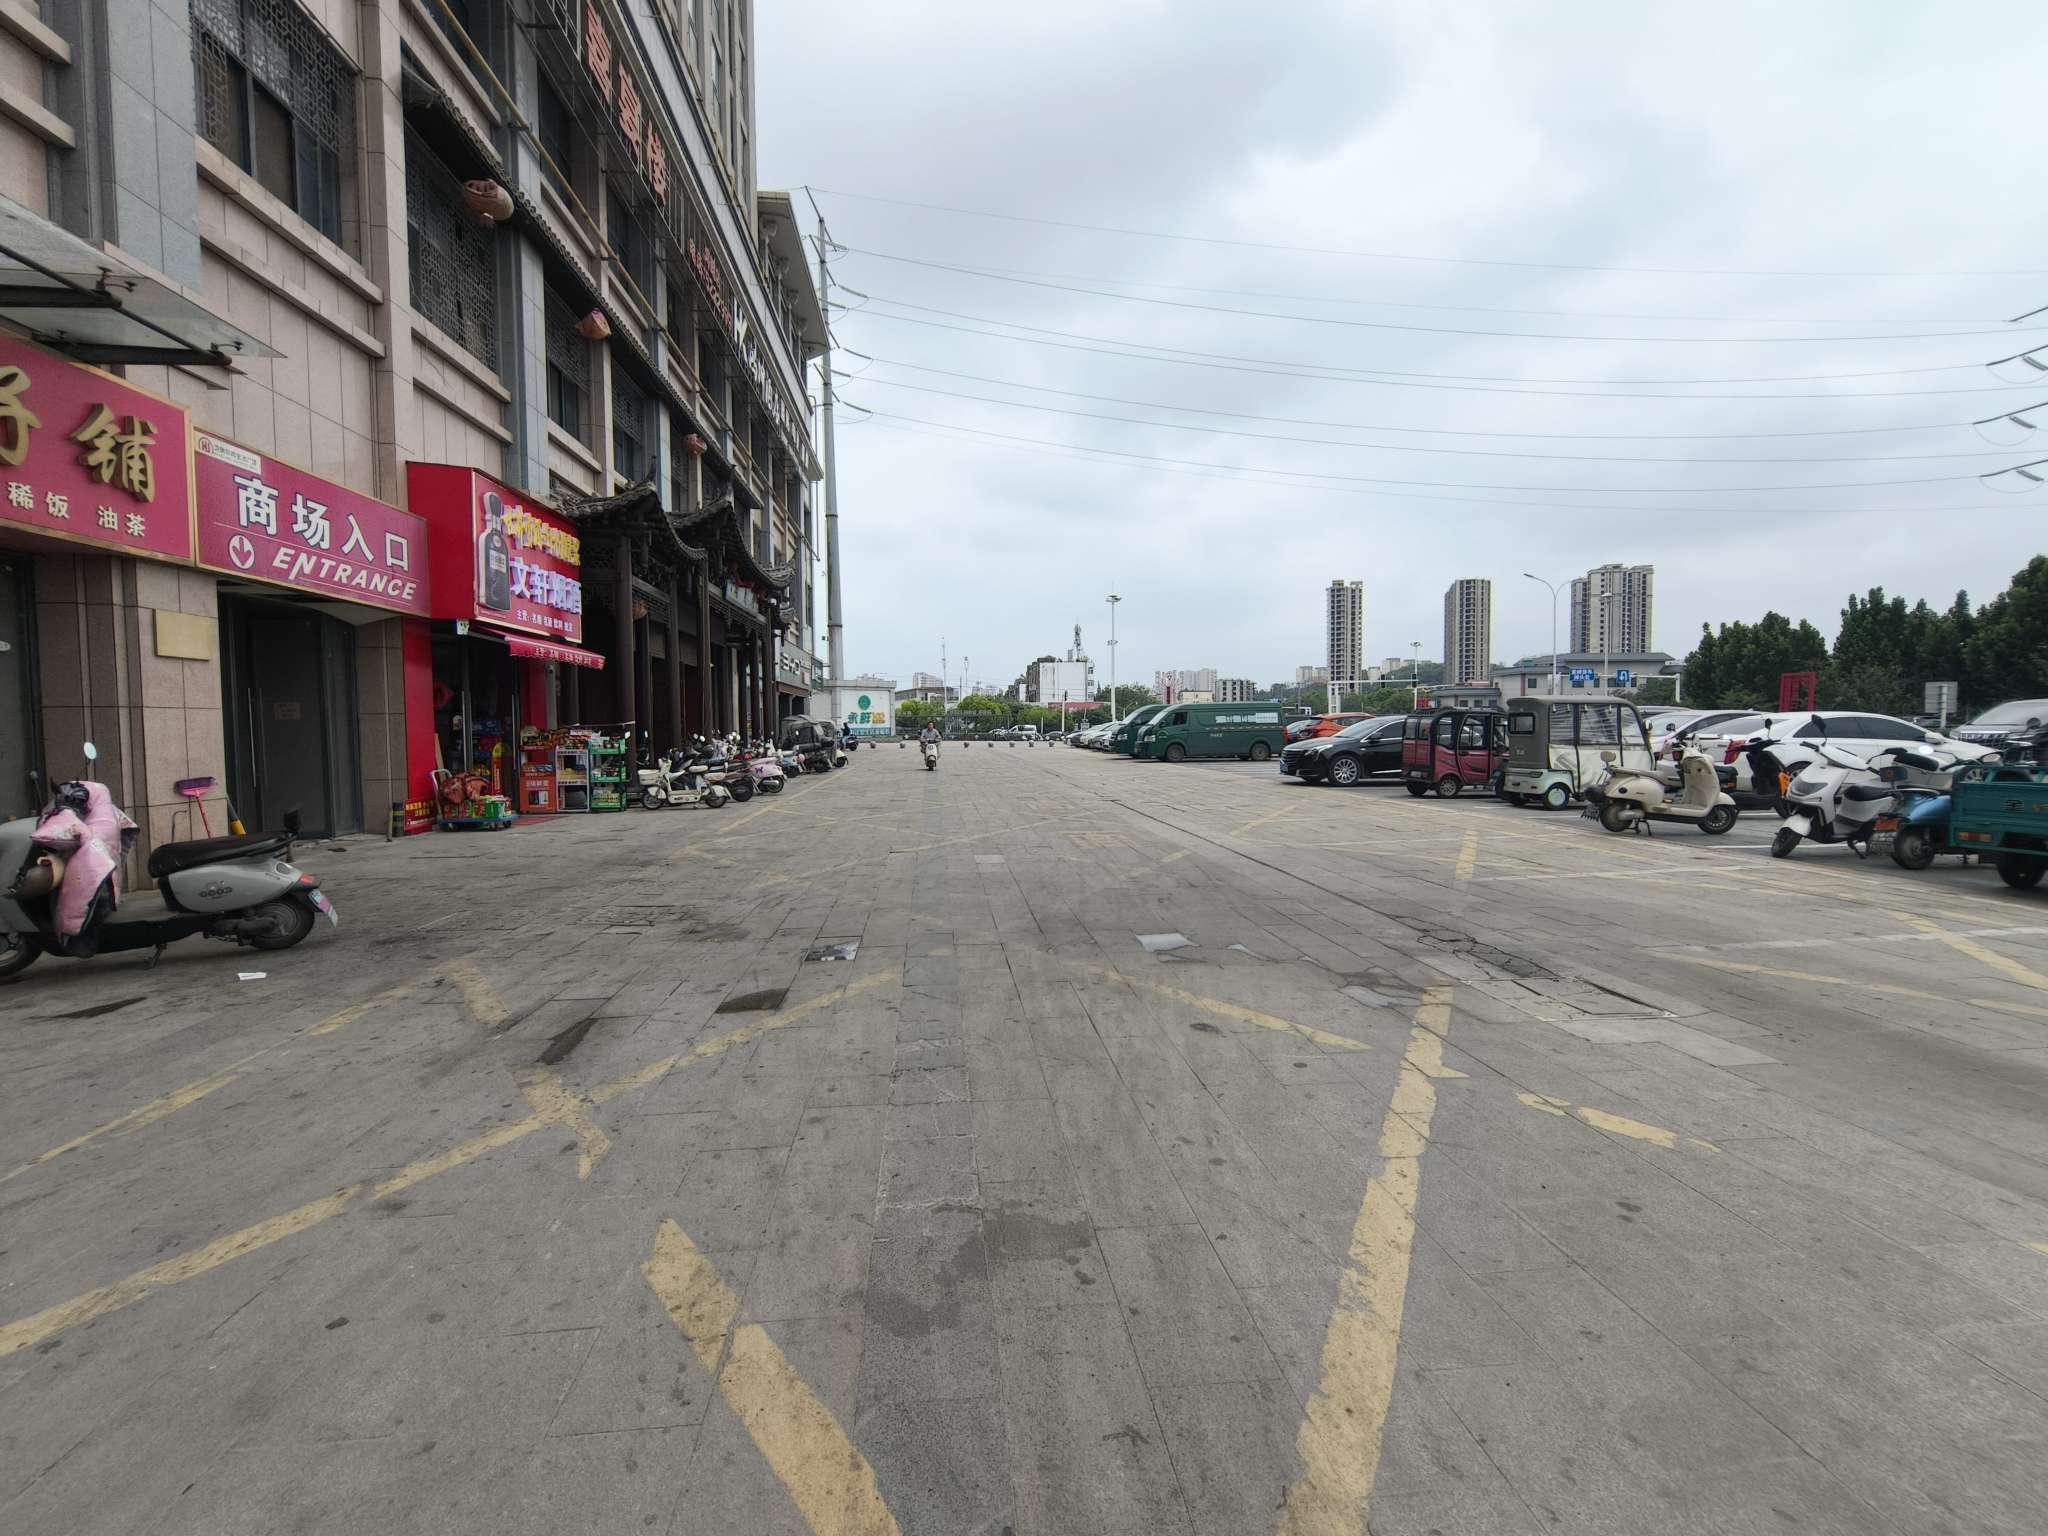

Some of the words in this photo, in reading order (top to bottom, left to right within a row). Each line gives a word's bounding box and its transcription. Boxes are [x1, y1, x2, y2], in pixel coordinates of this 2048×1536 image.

[8, 481, 70, 519] 稀饭
[98, 505, 146, 537] 油茶
[234, 475, 410, 571] 商场入口
[272, 546, 417, 601] ENTRANCE
